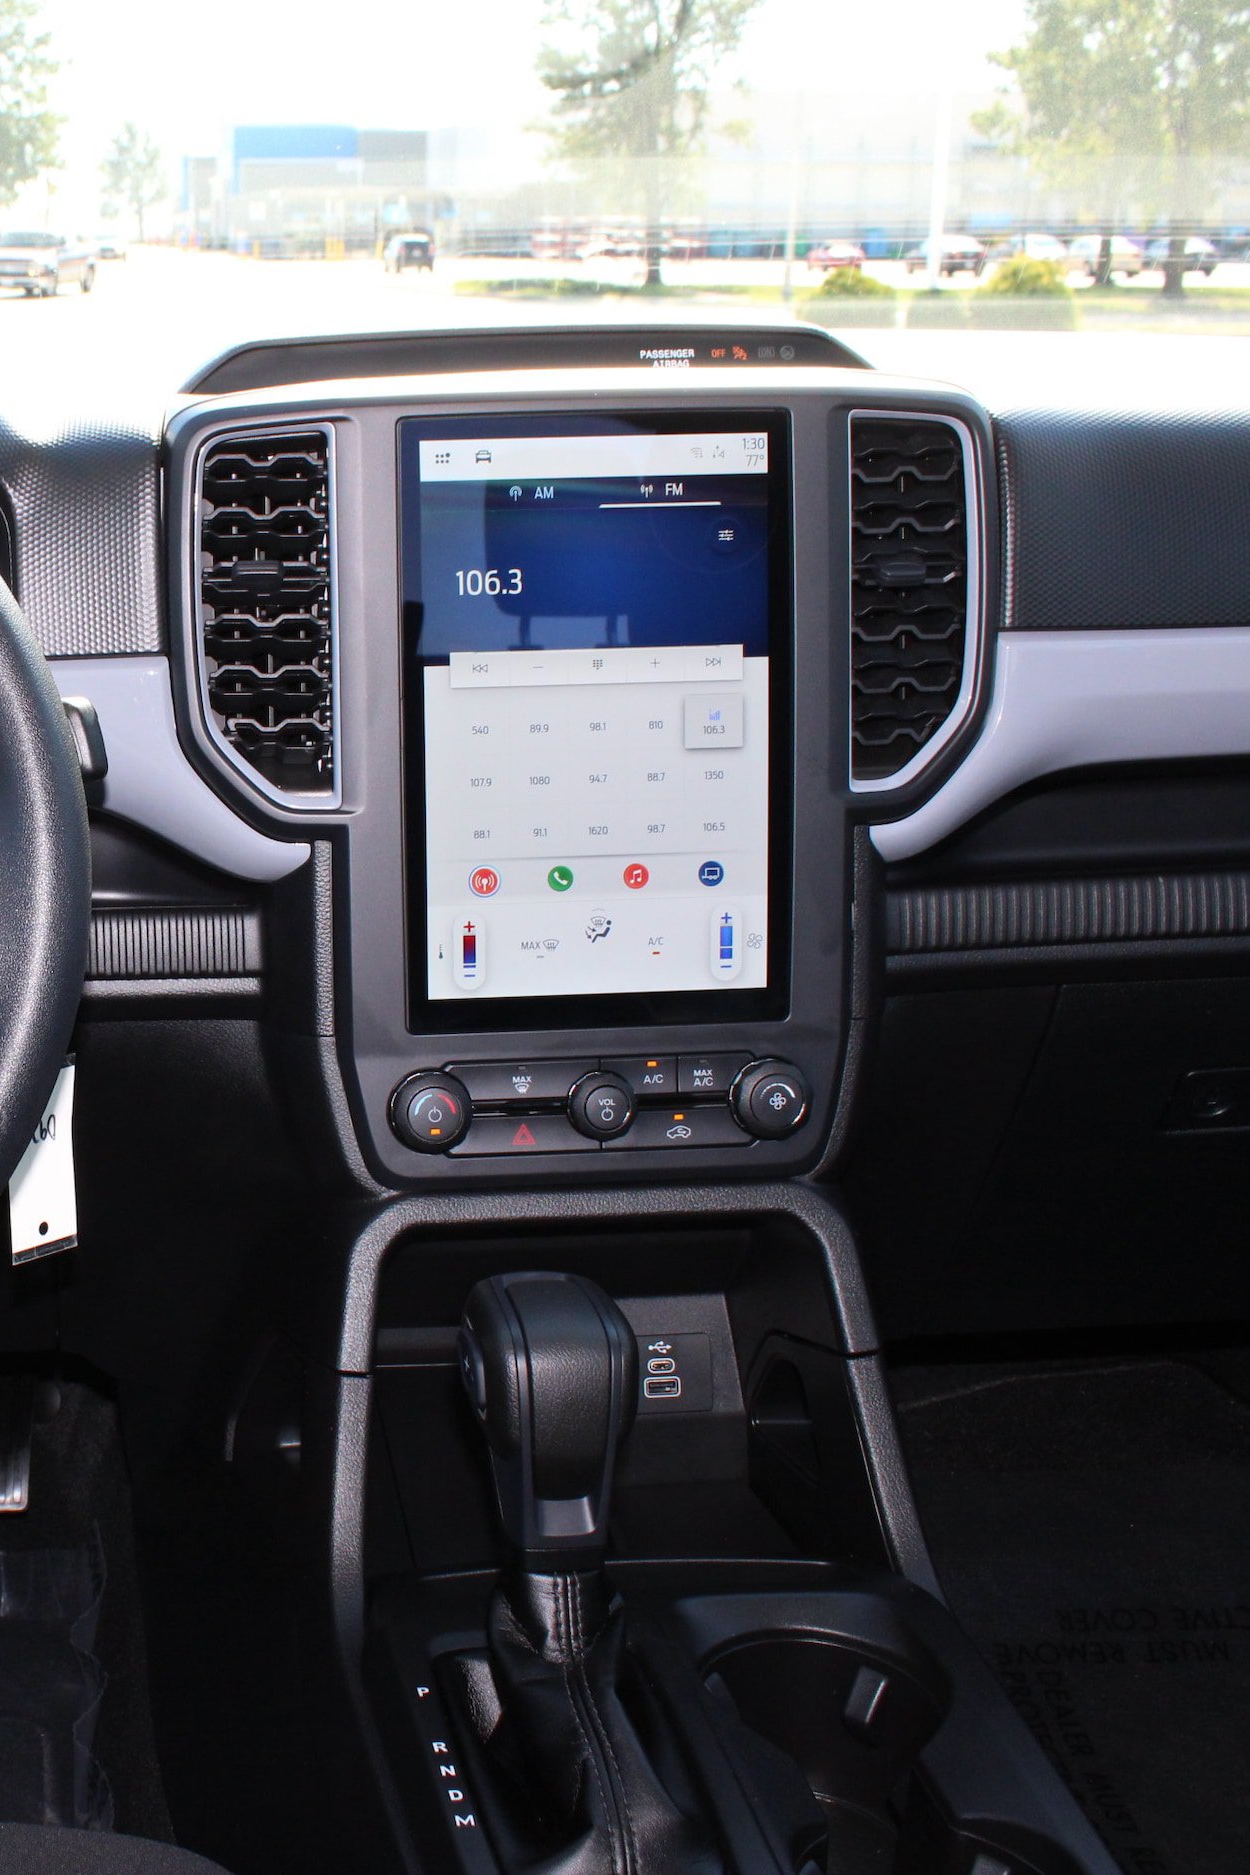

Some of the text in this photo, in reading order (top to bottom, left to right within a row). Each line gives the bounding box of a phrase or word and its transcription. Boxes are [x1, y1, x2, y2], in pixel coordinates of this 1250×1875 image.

[639, 348, 695, 359] PASSENGER
[711, 348, 726, 359] OFF
[652, 359, 690, 368] AIRBAG
[742, 437, 765, 450] 1:30
[746, 454, 765, 467] 77°
[533, 485, 555, 500] AM
[665, 482, 683, 497] FM
[455, 568, 523, 597] 106.3
[472, 725, 489, 736] 540
[529, 723, 549, 734] 89.9
[589, 721, 607, 732] 98.1
[648, 720, 663, 730] 810
[702, 725, 726, 735] 106.3
[588, 774, 608, 785] 94.7
[704, 770, 724, 780] 1350
[470, 777, 492, 788] 107.9
[533, 827, 548, 838] 91.1
[588, 825, 608, 836] 1620
[702, 822, 726, 832] 106.5
[473, 829, 491, 840] 88.1
[520, 940, 541, 951] MAX
[647, 936, 664, 947] A/C
[692, 1068, 714, 1077] MAX
[512, 1075, 532, 1084] MAX
[643, 1073, 664, 1085] A/C
[692, 1077, 714, 1087] A/C
[597, 1098, 617, 1107] VOL
[415, 1686, 430, 1698] P
[431, 1741, 449, 1753] R
[439, 1765, 457, 1777] N
[447, 1789, 464, 1801] D
[454, 1814, 476, 1827] M
